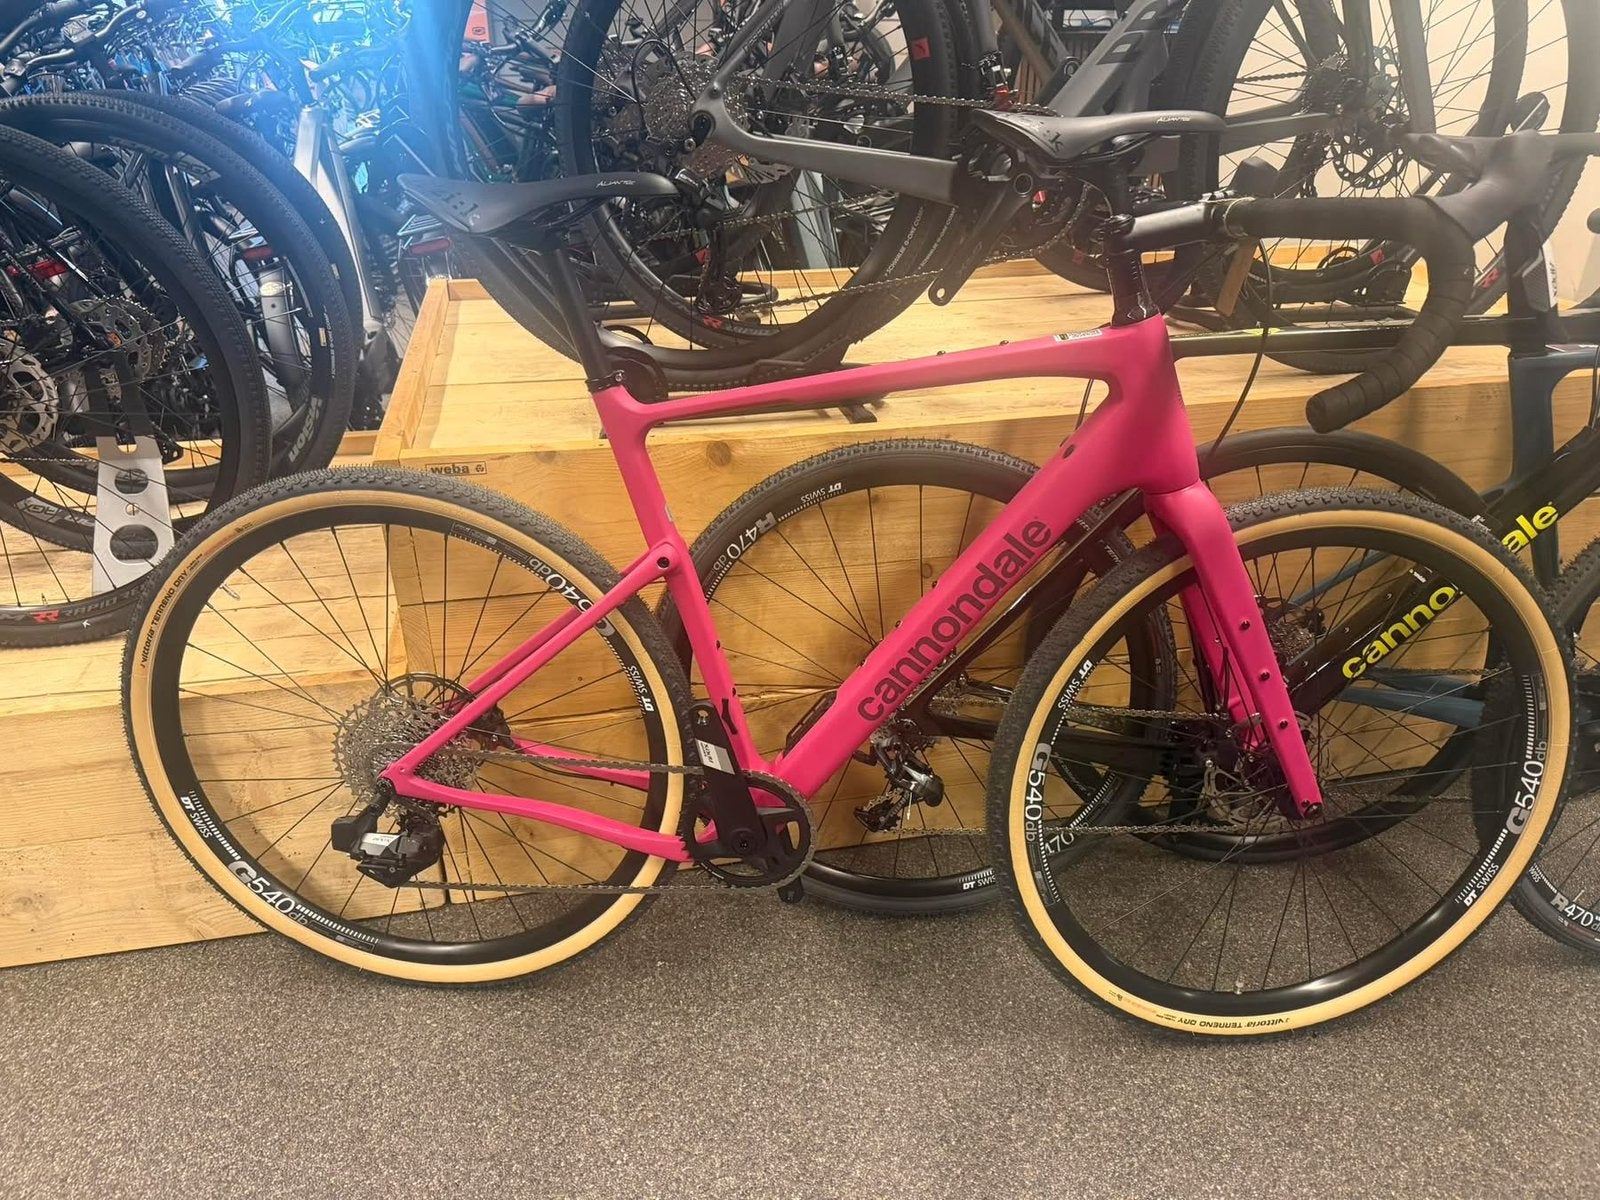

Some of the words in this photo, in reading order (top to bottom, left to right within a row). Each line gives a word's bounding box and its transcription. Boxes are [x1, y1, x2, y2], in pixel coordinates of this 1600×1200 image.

[430, 463, 470, 474] weba
[801, 487, 826, 504] SWISS
[828, 482, 842, 493] DT
[150, 587, 176, 627] TERRENO
[173, 569, 189, 588] DRY
[857, 519, 1052, 721] cannondale
[1079, 659, 1093, 679] DT
[628, 665, 648, 694] SWISS
[1057, 678, 1080, 711] SWISS
[641, 695, 655, 712] DT
[180, 796, 195, 812] DT
[189, 812, 214, 839] SWISS
[1528, 866, 1541, 883] WISS
[963, 881, 976, 890] DT
[1463, 889, 1478, 907] DT
[1476, 863, 1500, 891] SWISS
[1177, 1017, 1197, 1026] DRY
[1199, 1021, 1243, 1029] TERRENO
[1246, 1018, 1285, 1028] vittoria
